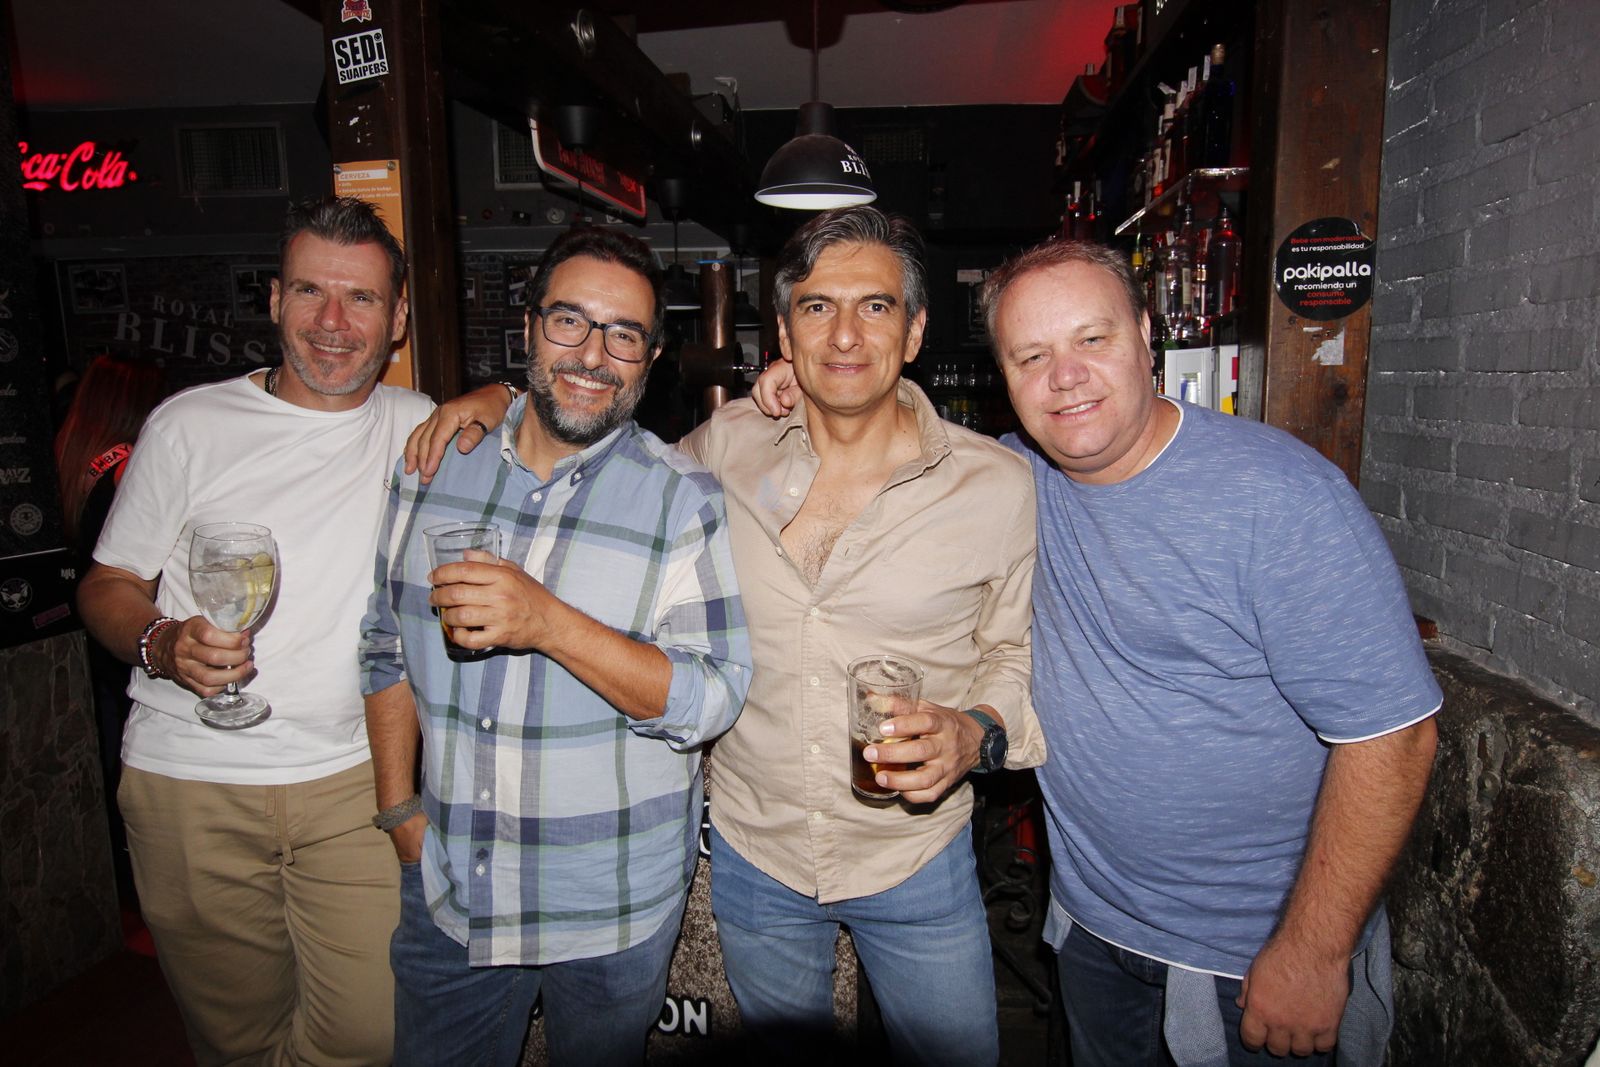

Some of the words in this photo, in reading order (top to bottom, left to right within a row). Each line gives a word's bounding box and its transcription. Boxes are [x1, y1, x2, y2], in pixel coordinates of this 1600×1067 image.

[340, 61, 388, 81] SUAIPERS
[340, 172, 369, 180] CERVEZA
[1309, 242, 1365, 253] responsabilidad
[1283, 261, 1371, 283] pakipalla
[1294, 281, 1344, 291] recomienda
[1299, 298, 1352, 307] responsable
[152, 294, 235, 329] ROYAL
[113, 311, 266, 366] BLISS
